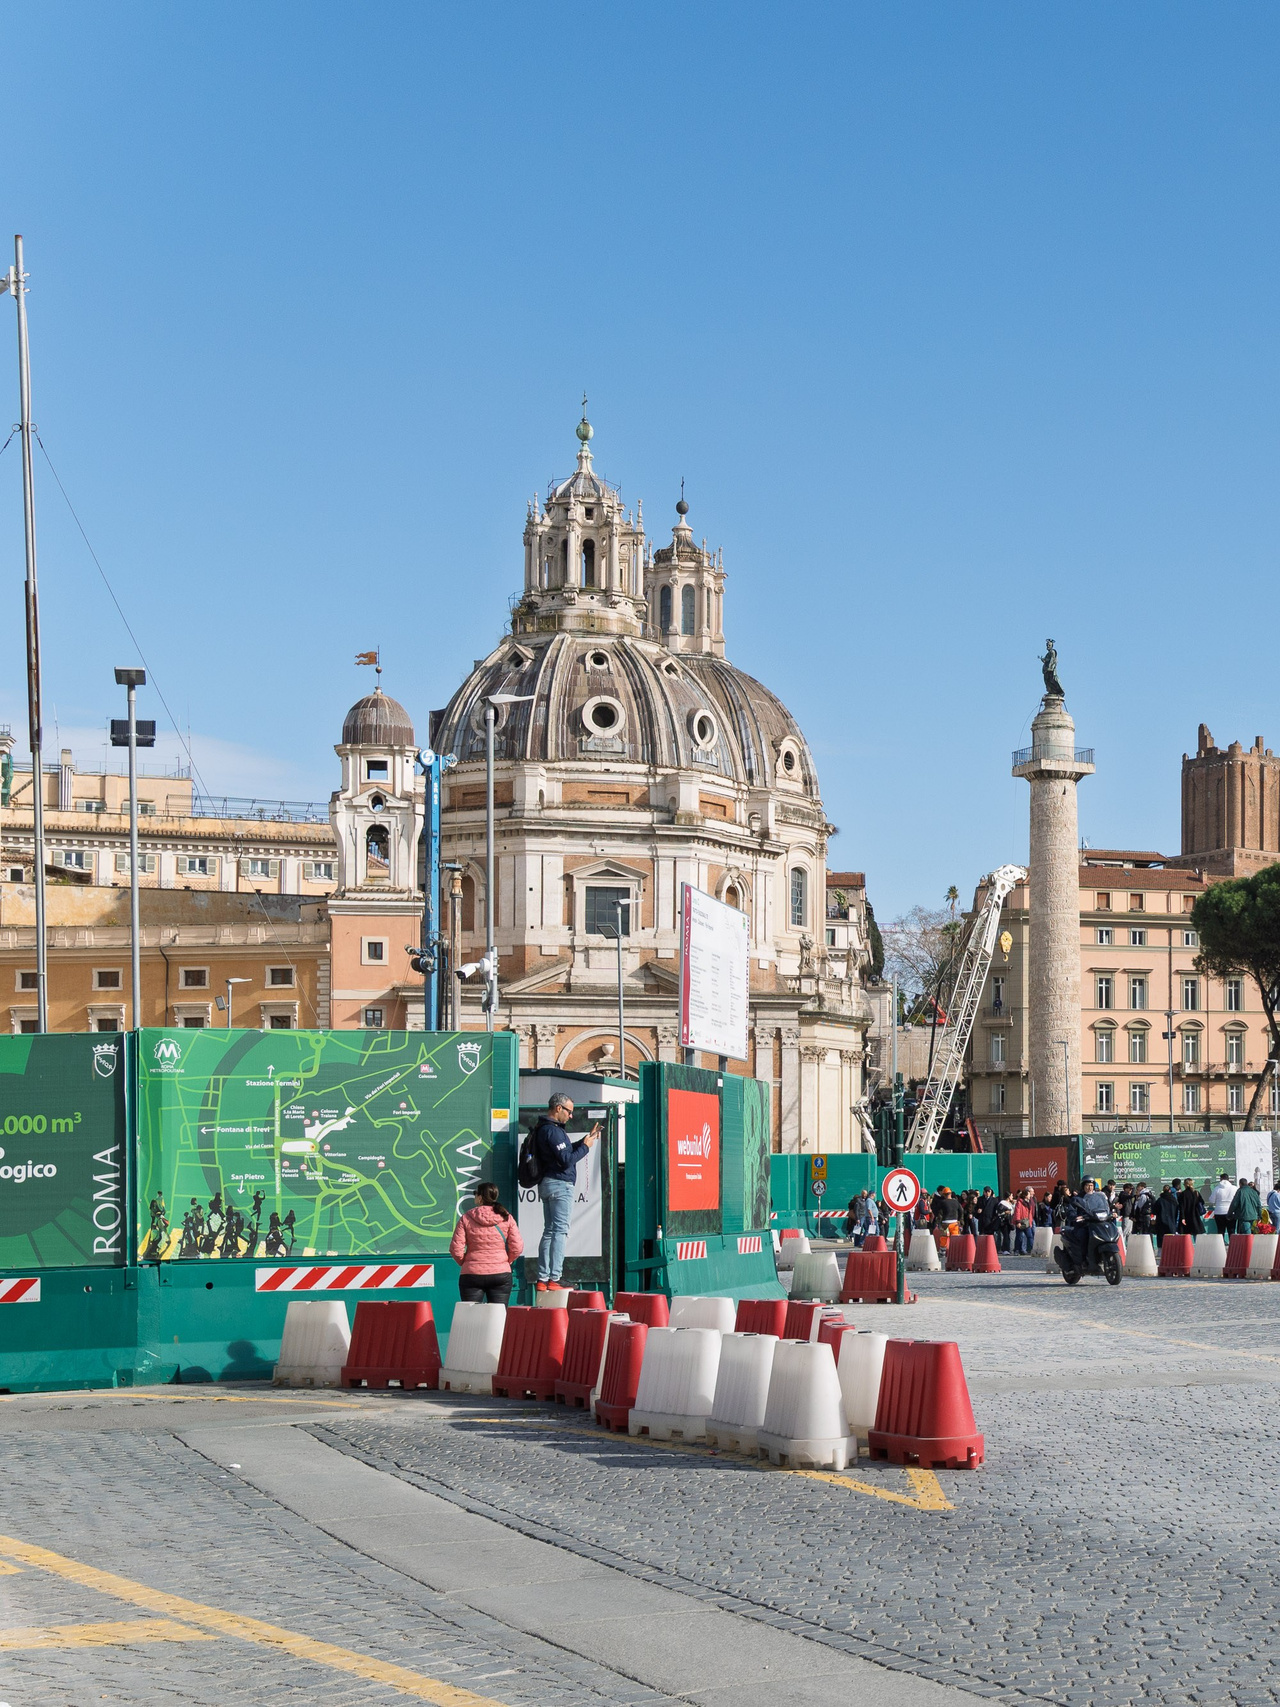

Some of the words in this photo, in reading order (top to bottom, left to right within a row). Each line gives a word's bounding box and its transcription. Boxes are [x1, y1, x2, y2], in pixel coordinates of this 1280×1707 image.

[677, 1134, 702, 1156] webuild
[1113, 1141, 1150, 1150] Costruire
[1113, 1151, 1142, 1160] futuro:
[1183, 1150, 1191, 1158] 17
[1019, 1168, 1047, 1178] webuild
[1215, 1167, 1224, 1175] 22
[92, 1143, 122, 1254] ROMA
